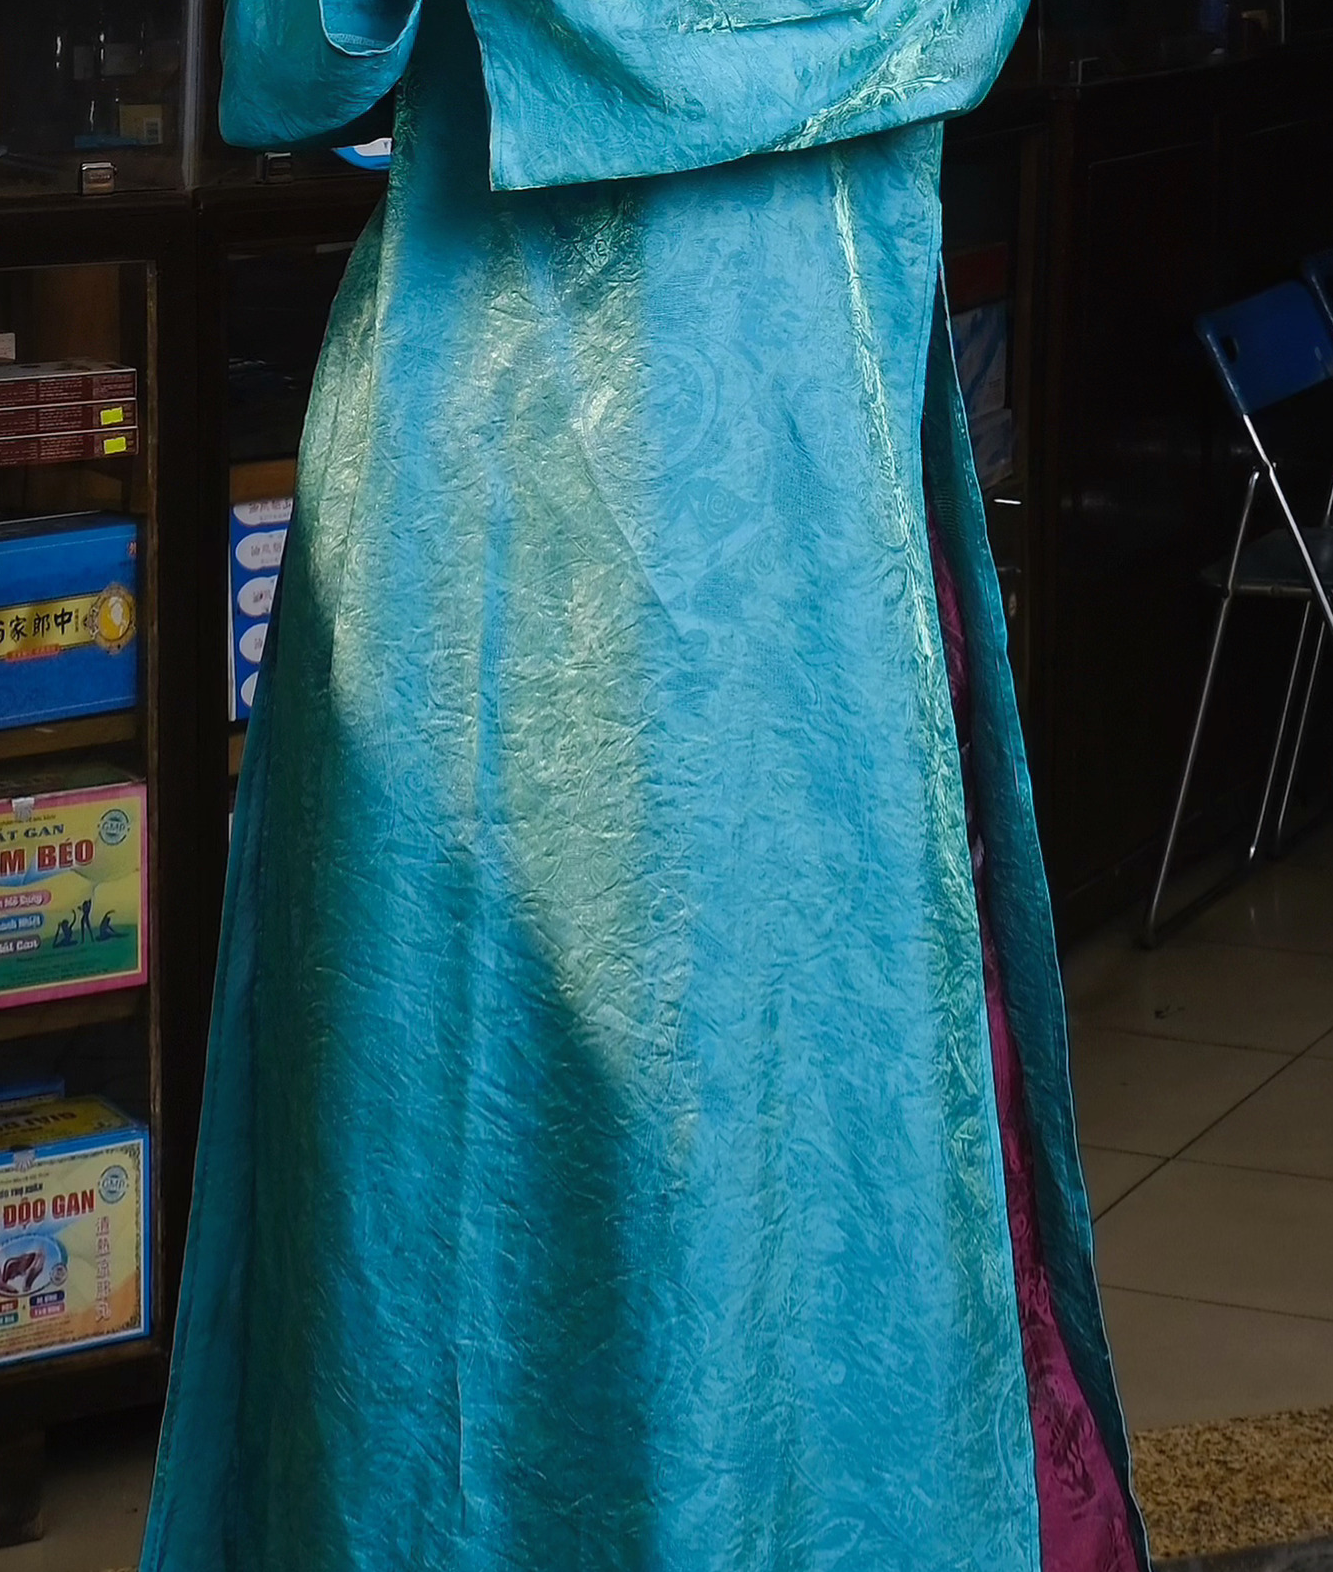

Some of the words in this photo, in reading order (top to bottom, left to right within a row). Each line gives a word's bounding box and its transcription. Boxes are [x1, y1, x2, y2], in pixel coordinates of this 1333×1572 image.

[24, 823, 65, 839] GAN
[37, 837, 95, 870] BÉO
[2, 1195, 47, 1231] ĐỘC
[51, 1188, 96, 1220] GAN
